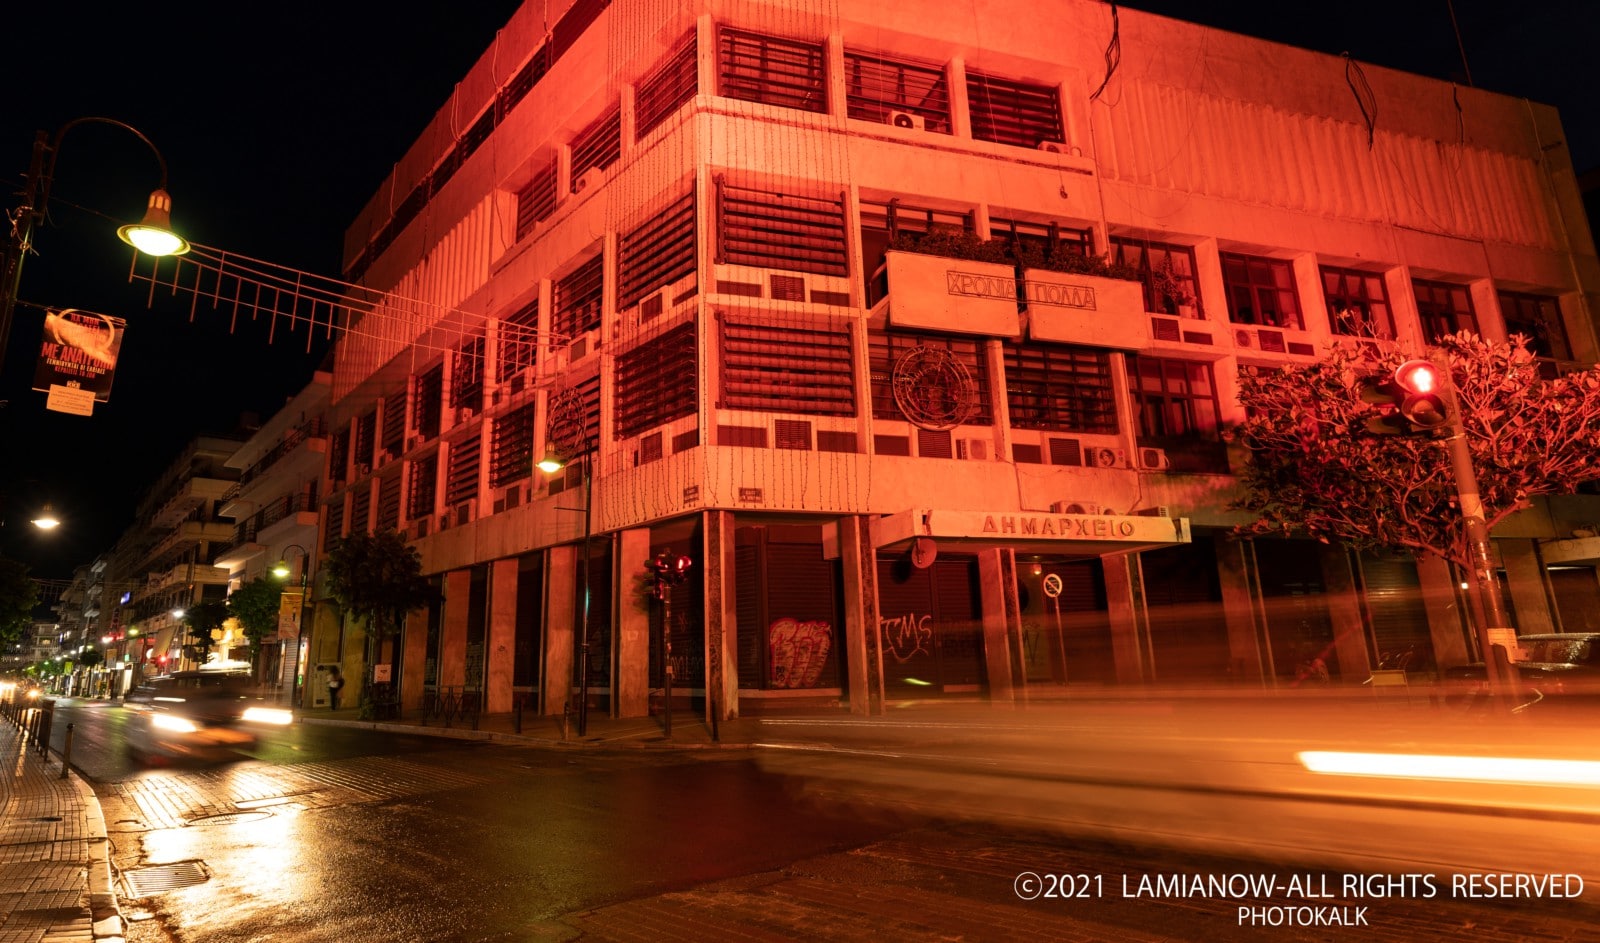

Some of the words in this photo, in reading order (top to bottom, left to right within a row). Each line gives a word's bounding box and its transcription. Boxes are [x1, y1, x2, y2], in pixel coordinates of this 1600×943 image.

[949, 272, 1017, 299] ΧΡΟΝΙΑ
[1034, 284, 1096, 308] ΠΟΛΛΑ
[982, 515, 1136, 537] ΔΗΜΑΡΧΕΙΟ
